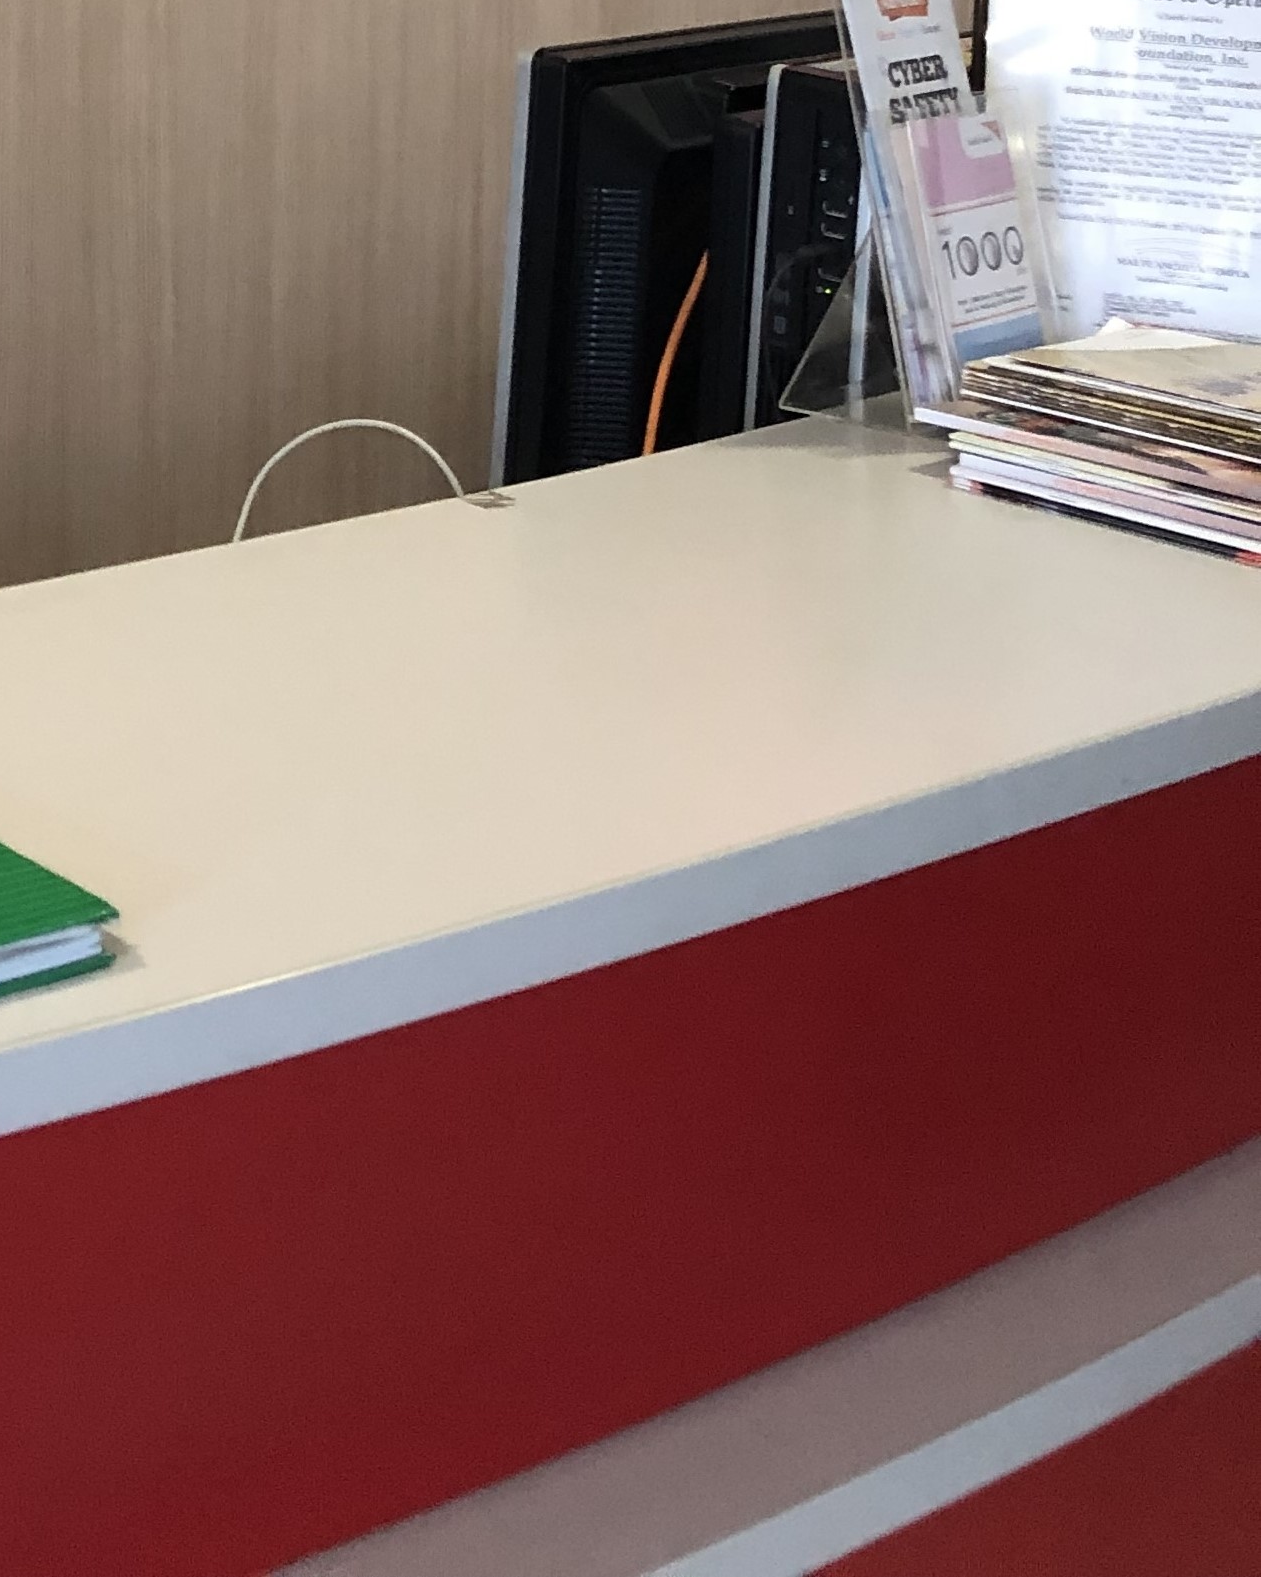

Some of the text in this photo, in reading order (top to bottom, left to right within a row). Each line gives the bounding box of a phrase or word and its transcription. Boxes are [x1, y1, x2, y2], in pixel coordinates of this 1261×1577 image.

[1089, 25, 1135, 41] World
[1139, 28, 1187, 45] Vision
[888, 54, 949, 89] CYBER
[941, 225, 1024, 281] 1000
